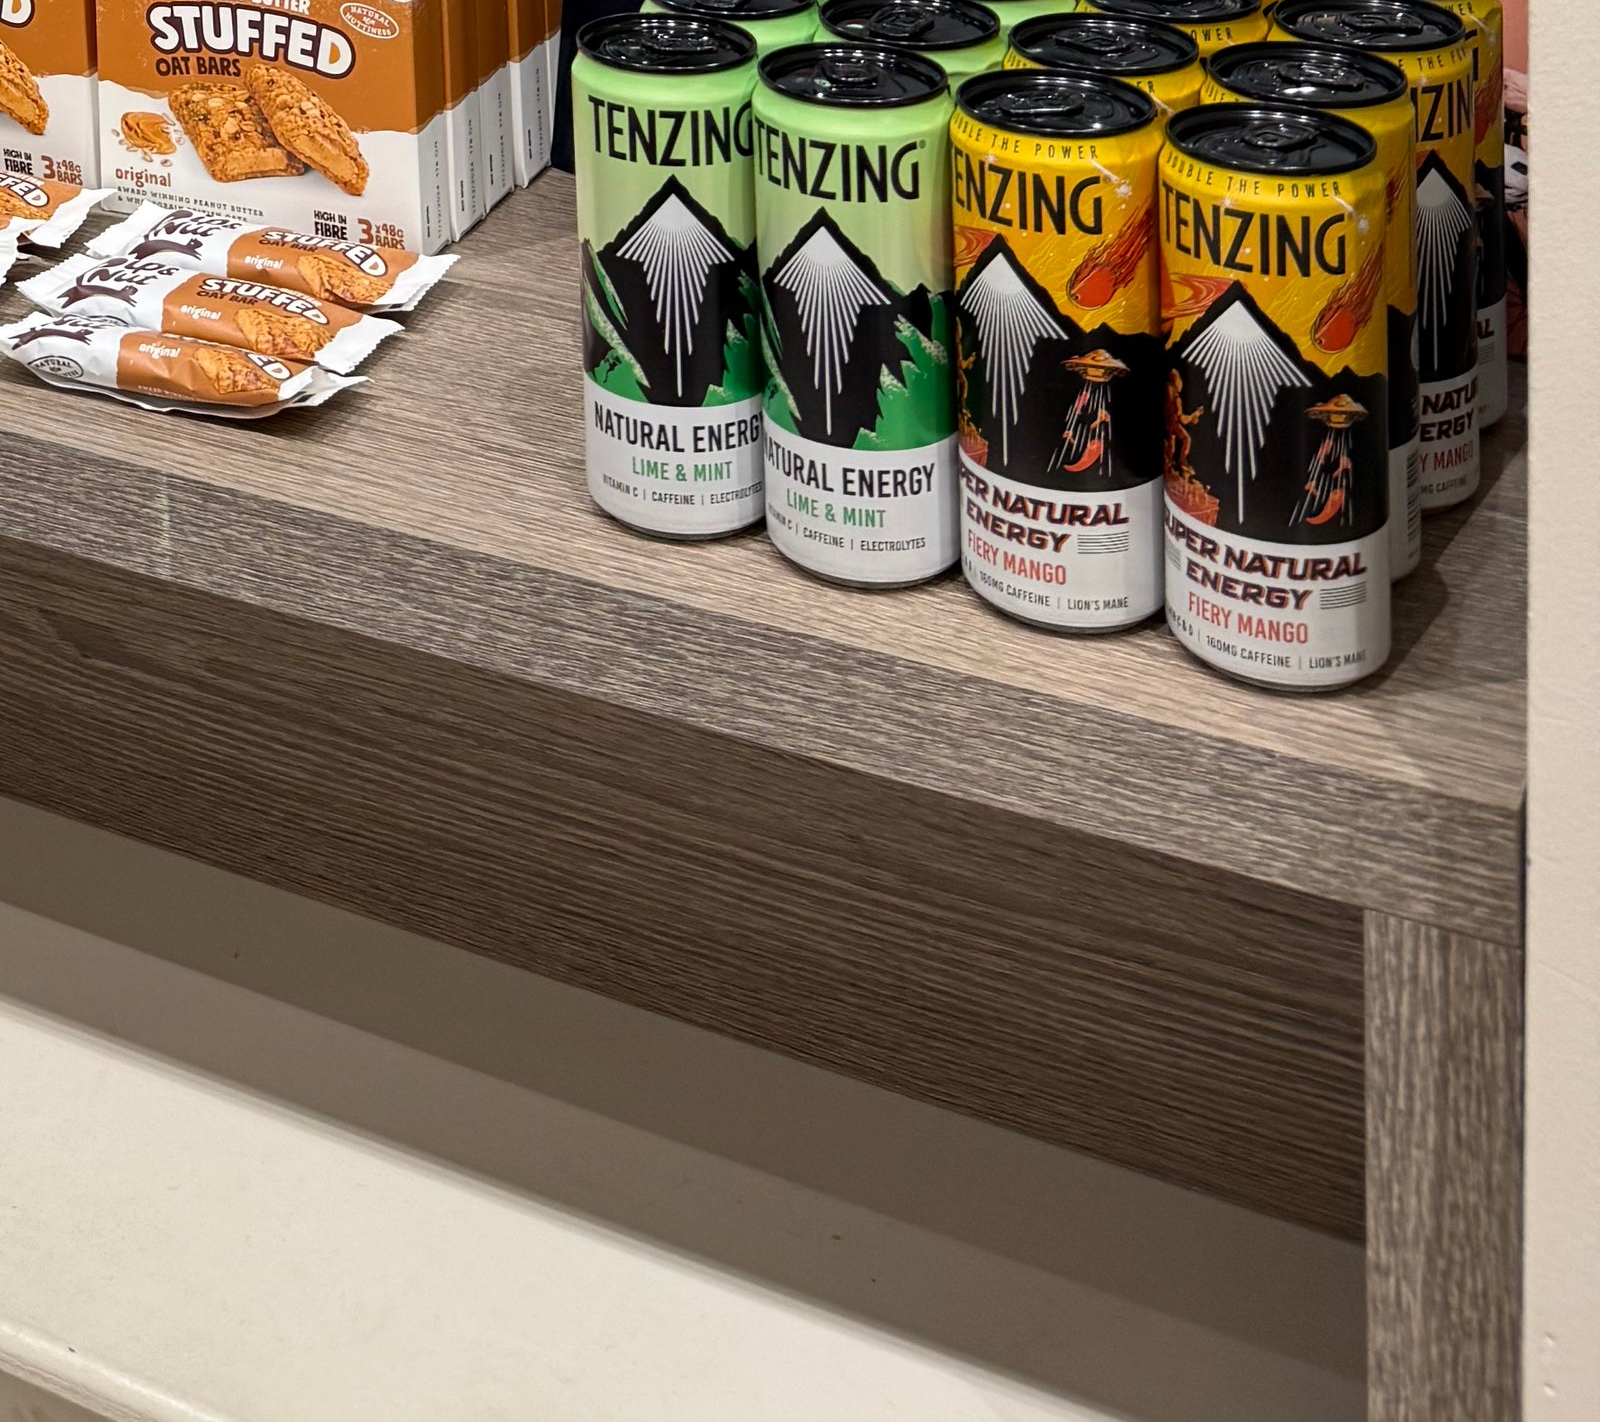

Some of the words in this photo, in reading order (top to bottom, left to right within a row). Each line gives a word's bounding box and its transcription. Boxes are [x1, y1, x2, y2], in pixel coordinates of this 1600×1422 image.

[350, 5, 390, 27] NATURAL
[148, 4, 354, 77] STUFFED
[156, 57, 190, 76] OAT
[197, 58, 241, 77] BARS
[587, 95, 754, 167] TENZING
[2, 148, 22, 160] HIGH
[755, 114, 920, 203] TENZING
[992, 133, 1020, 154] THE
[1035, 143, 1098, 160] POWER
[4, 158, 33, 176] FIBRE
[41, 155, 56, 179] 3
[57, 171, 83, 186] BARS
[115, 167, 172, 189] original
[954, 144, 1102, 236] ENZING
[1227, 176, 1261, 196] THE
[1277, 180, 1342, 198] POWER
[314, 210, 336, 224] HIGH
[338, 215, 347, 224] IN
[1162, 179, 1347, 278] TENZING
[314, 222, 348, 240] FIBRE
[357, 218, 374, 244] 3
[375, 235, 405, 250] BARS
[244, 255, 283, 271] original
[180, 304, 222, 321] original
[200, 277, 329, 325] STUFFED
[138, 342, 181, 361] original
[594, 400, 685, 453] NATURAL
[631, 455, 670, 481] LIME
[675, 460, 690, 480] &
[693, 459, 733, 481] MINT
[843, 463, 935, 501] ENERGY
[651, 491, 696, 506] CAFFEINE
[786, 488, 820, 518] LIME
[825, 503, 837, 524] &
[841, 504, 887, 531] MINT
[992, 480, 1129, 528] NATURAL
[966, 496, 1072, 553] ENERGY
[803, 526, 845, 549] CAFFEINE
[861, 535, 927, 553] ELECTROLYTES
[967, 531, 999, 566] FIERY
[1003, 550, 1067, 586] MANGO
[1224, 544, 1368, 582] NATURAL
[1186, 555, 1313, 611] ENERGY
[1006, 584, 1051, 607] CAFFEINE
[1067, 597, 1100, 611] LION'S
[1103, 596, 1129, 610] MANE
[1188, 591, 1232, 630] FIERY
[1237, 612, 1309, 645] MANGO
[1206, 635, 1237, 658] 160MG
[1240, 646, 1291, 669] CAFFEINE
[1309, 655, 1341, 669] LION'S
